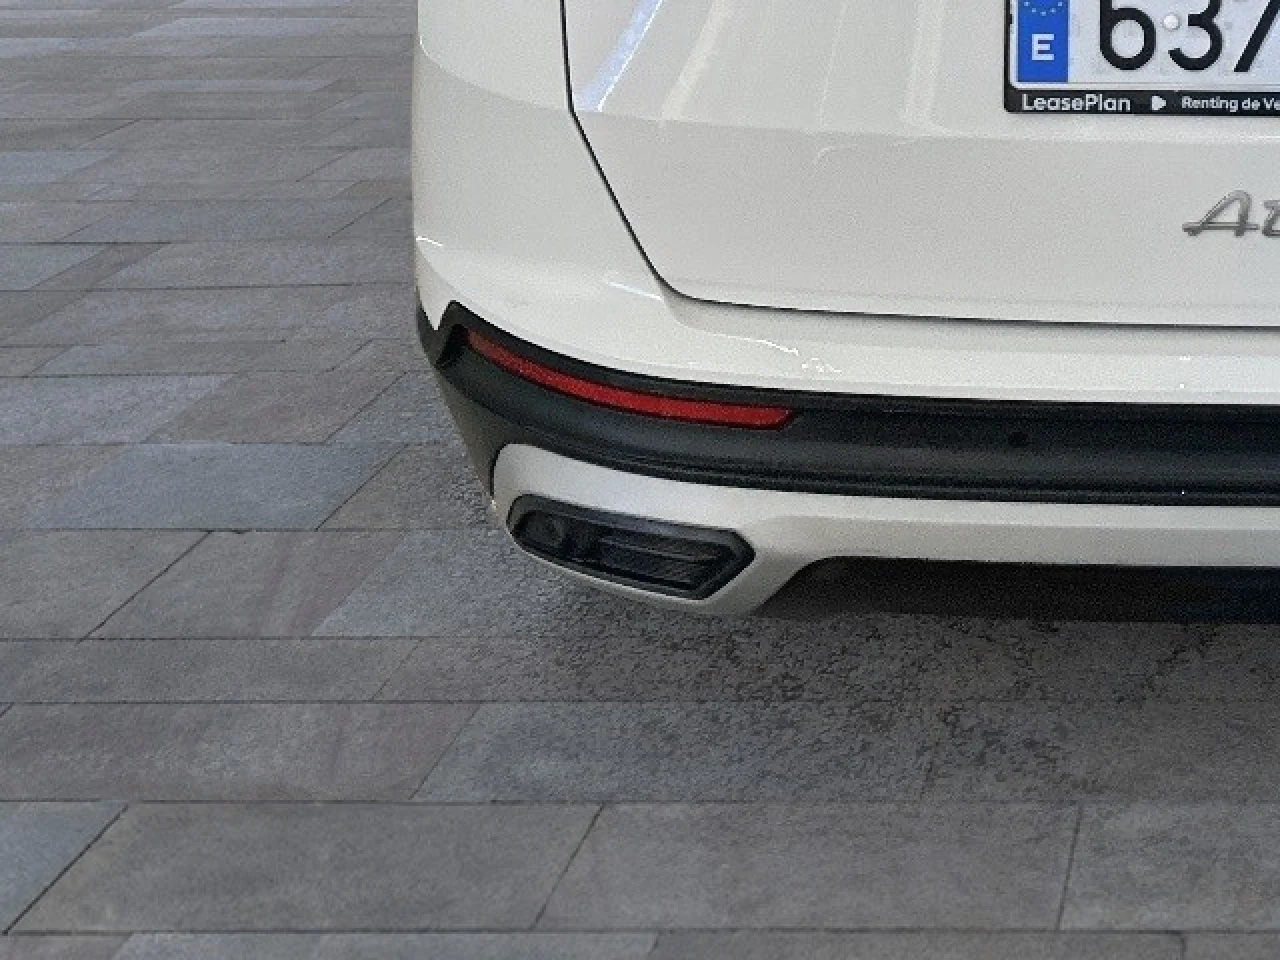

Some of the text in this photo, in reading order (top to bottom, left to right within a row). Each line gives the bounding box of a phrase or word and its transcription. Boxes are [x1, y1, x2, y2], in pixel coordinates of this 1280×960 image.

[1031, 33, 1055, 60] E
[1021, 93, 1131, 112] LeasePlan
[1181, 95, 1238, 113] Renting
[1241, 96, 1260, 110] de
